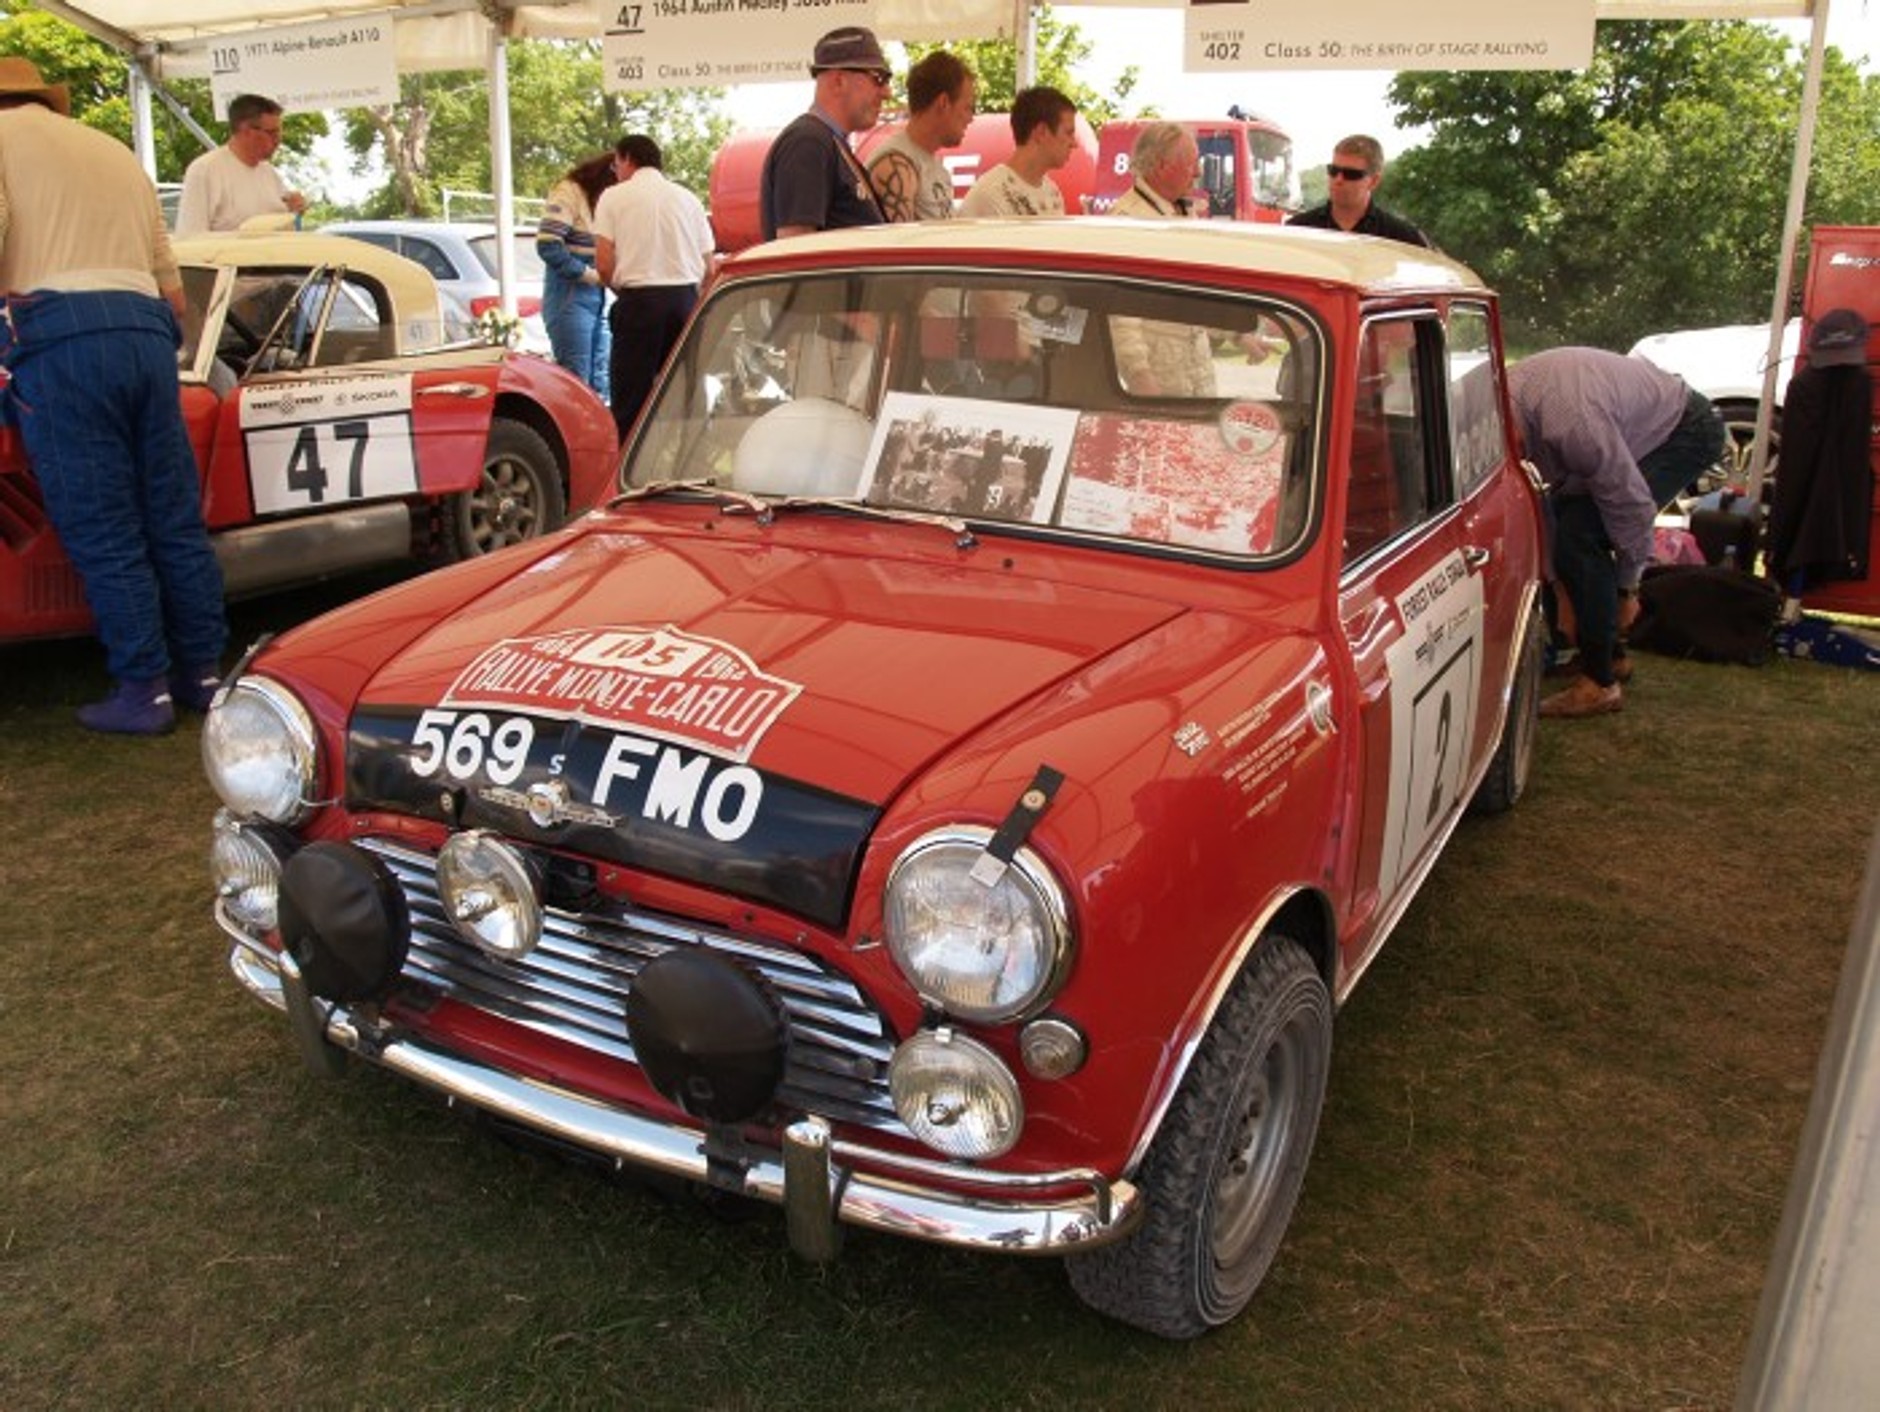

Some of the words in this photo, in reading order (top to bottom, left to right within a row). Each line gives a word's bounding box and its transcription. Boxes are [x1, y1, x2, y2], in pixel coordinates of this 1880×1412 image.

[617, 6, 642, 28] 47
[653, 0, 685, 16] 1964
[690, 0, 734, 14] Austin
[350, 27, 380, 43] A110
[213, 47, 240, 69] 110
[1204, 42, 1240, 60] 402
[1264, 42, 1311, 58] Class
[1415, 43, 1434, 56] OF
[1438, 43, 1478, 56] STAGE
[618, 64, 643, 79] 403
[658, 64, 690, 78] Class
[287, 422, 369, 503] 47
[547, 666, 778, 737] MONTE-CARLO
[1426, 690, 1450, 828] 2
[409, 709, 534, 785] 569
[592, 736, 764, 842] FMO
